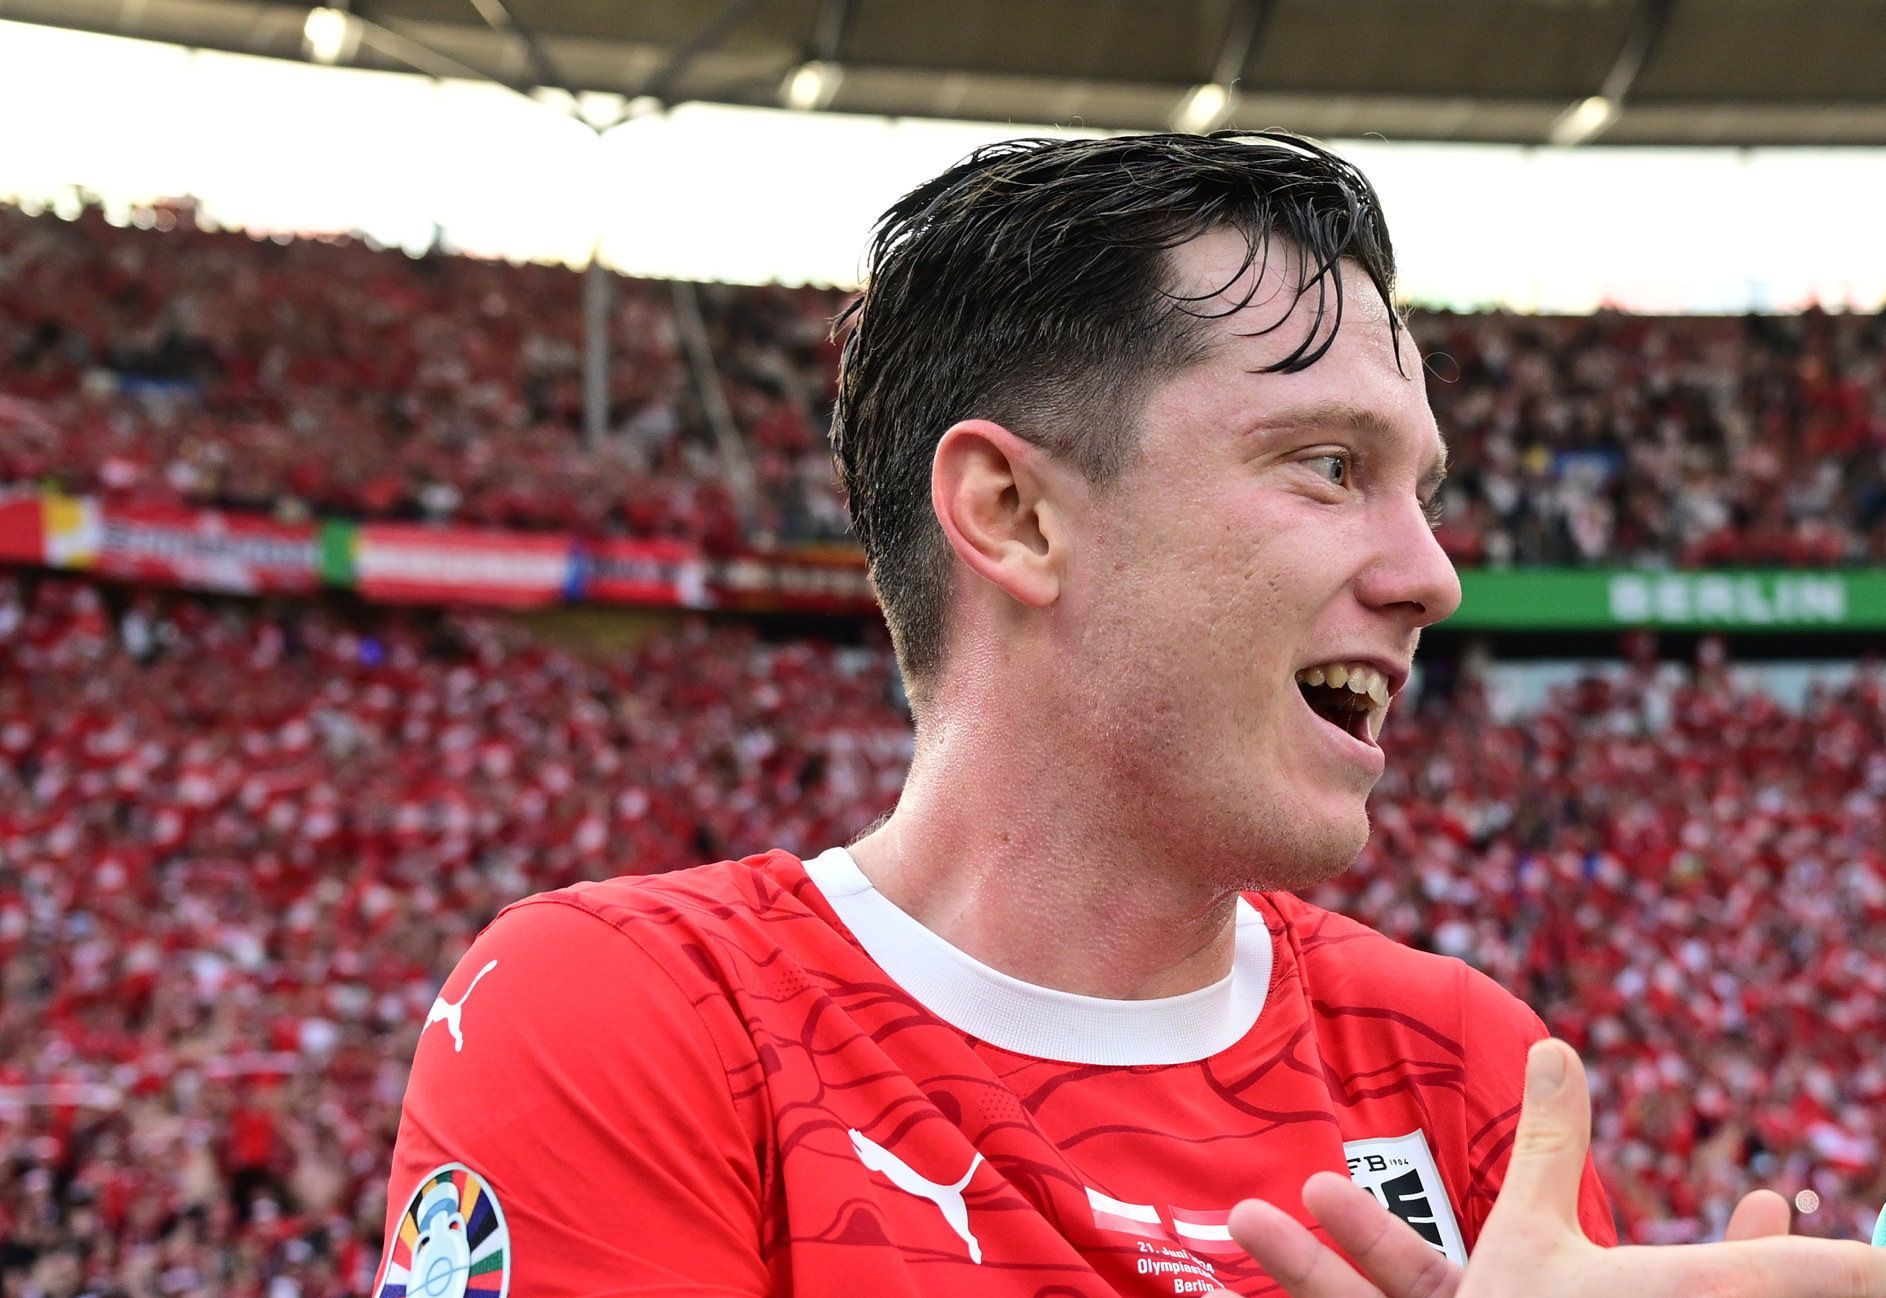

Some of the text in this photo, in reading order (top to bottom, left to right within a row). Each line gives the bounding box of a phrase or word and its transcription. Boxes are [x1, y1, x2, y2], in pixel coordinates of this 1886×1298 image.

[1608, 574, 1846, 623] BERLIN
[1346, 1154, 1387, 1176] FB
[1137, 1241, 1160, 1254] 21.
[1162, 1246, 1189, 1260] Juni
[1173, 1278, 1215, 1294] Berlin
